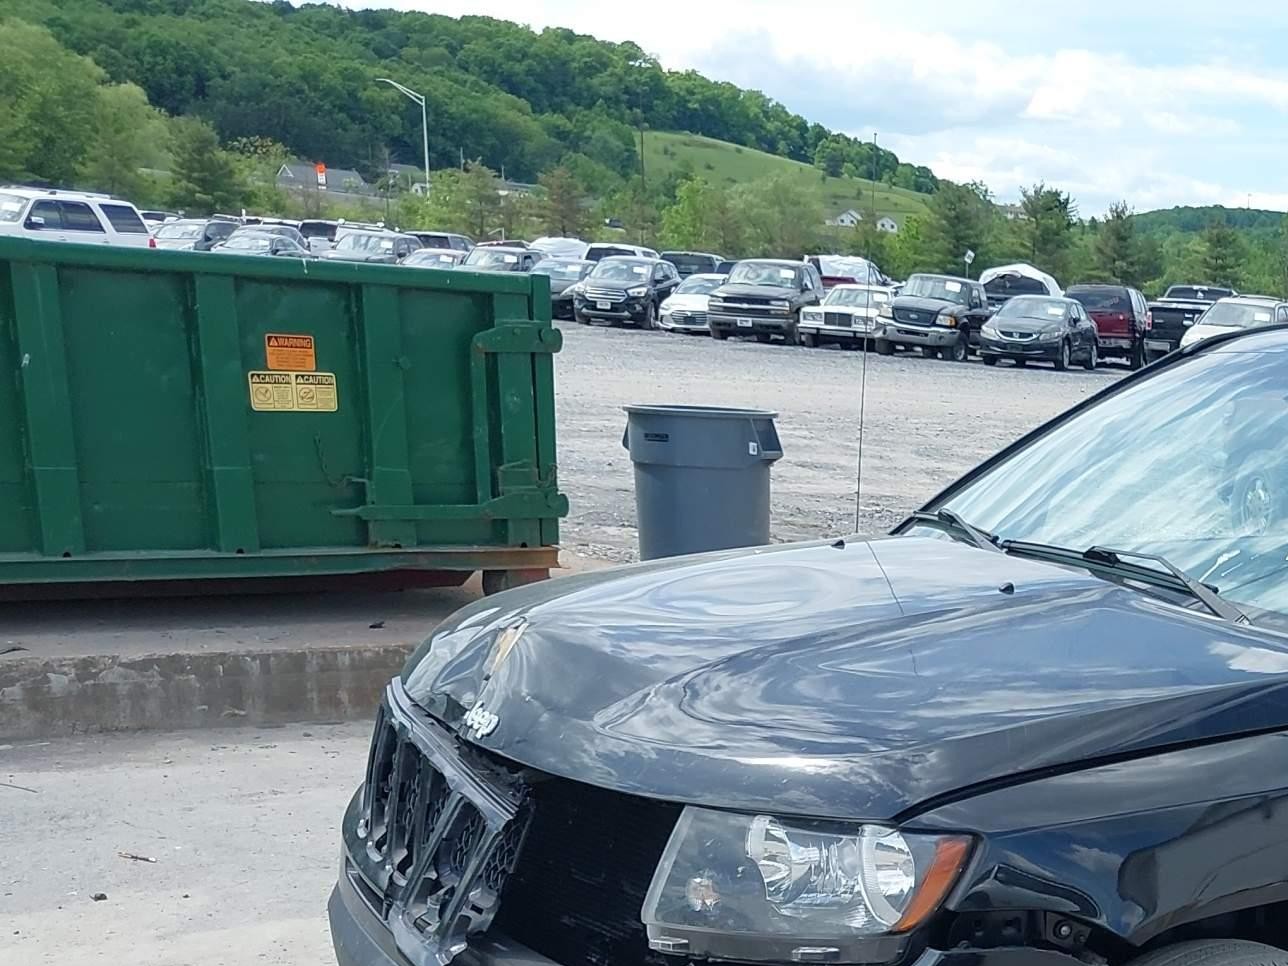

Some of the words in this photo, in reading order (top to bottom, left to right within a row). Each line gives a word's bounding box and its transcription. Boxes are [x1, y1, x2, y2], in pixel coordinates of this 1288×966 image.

[277, 337, 311, 348] WARNING
[259, 375, 292, 384] CAUTION
[304, 376, 334, 385] CAUTION
[464, 700, 499, 739] Jeep
